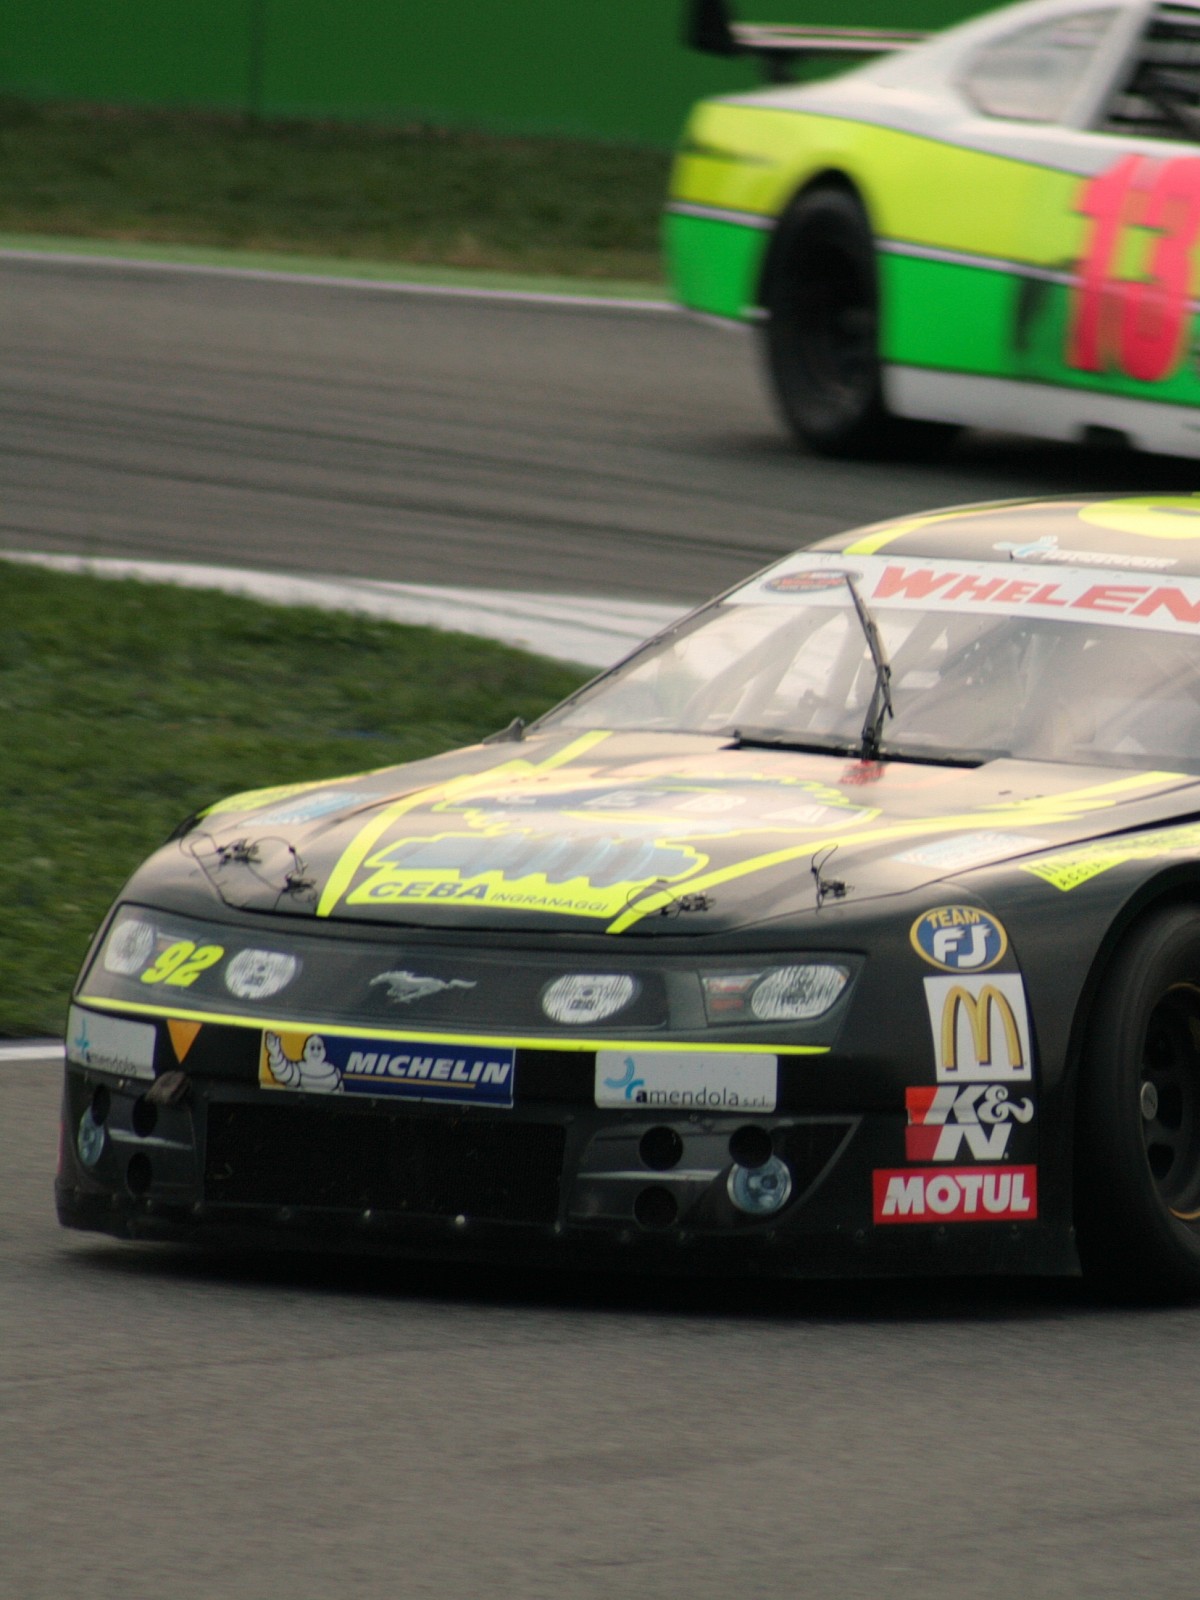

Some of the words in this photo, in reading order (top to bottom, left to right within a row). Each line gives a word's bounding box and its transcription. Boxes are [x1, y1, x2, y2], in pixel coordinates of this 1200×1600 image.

[926, 909, 981, 927] TEAM
[141, 941, 224, 987] 92
[933, 924, 992, 967] FJ
[345, 1050, 512, 1085] MICHELIN
[636, 1086, 739, 1107] amendola
[881, 1173, 1031, 1216] MOTUL
